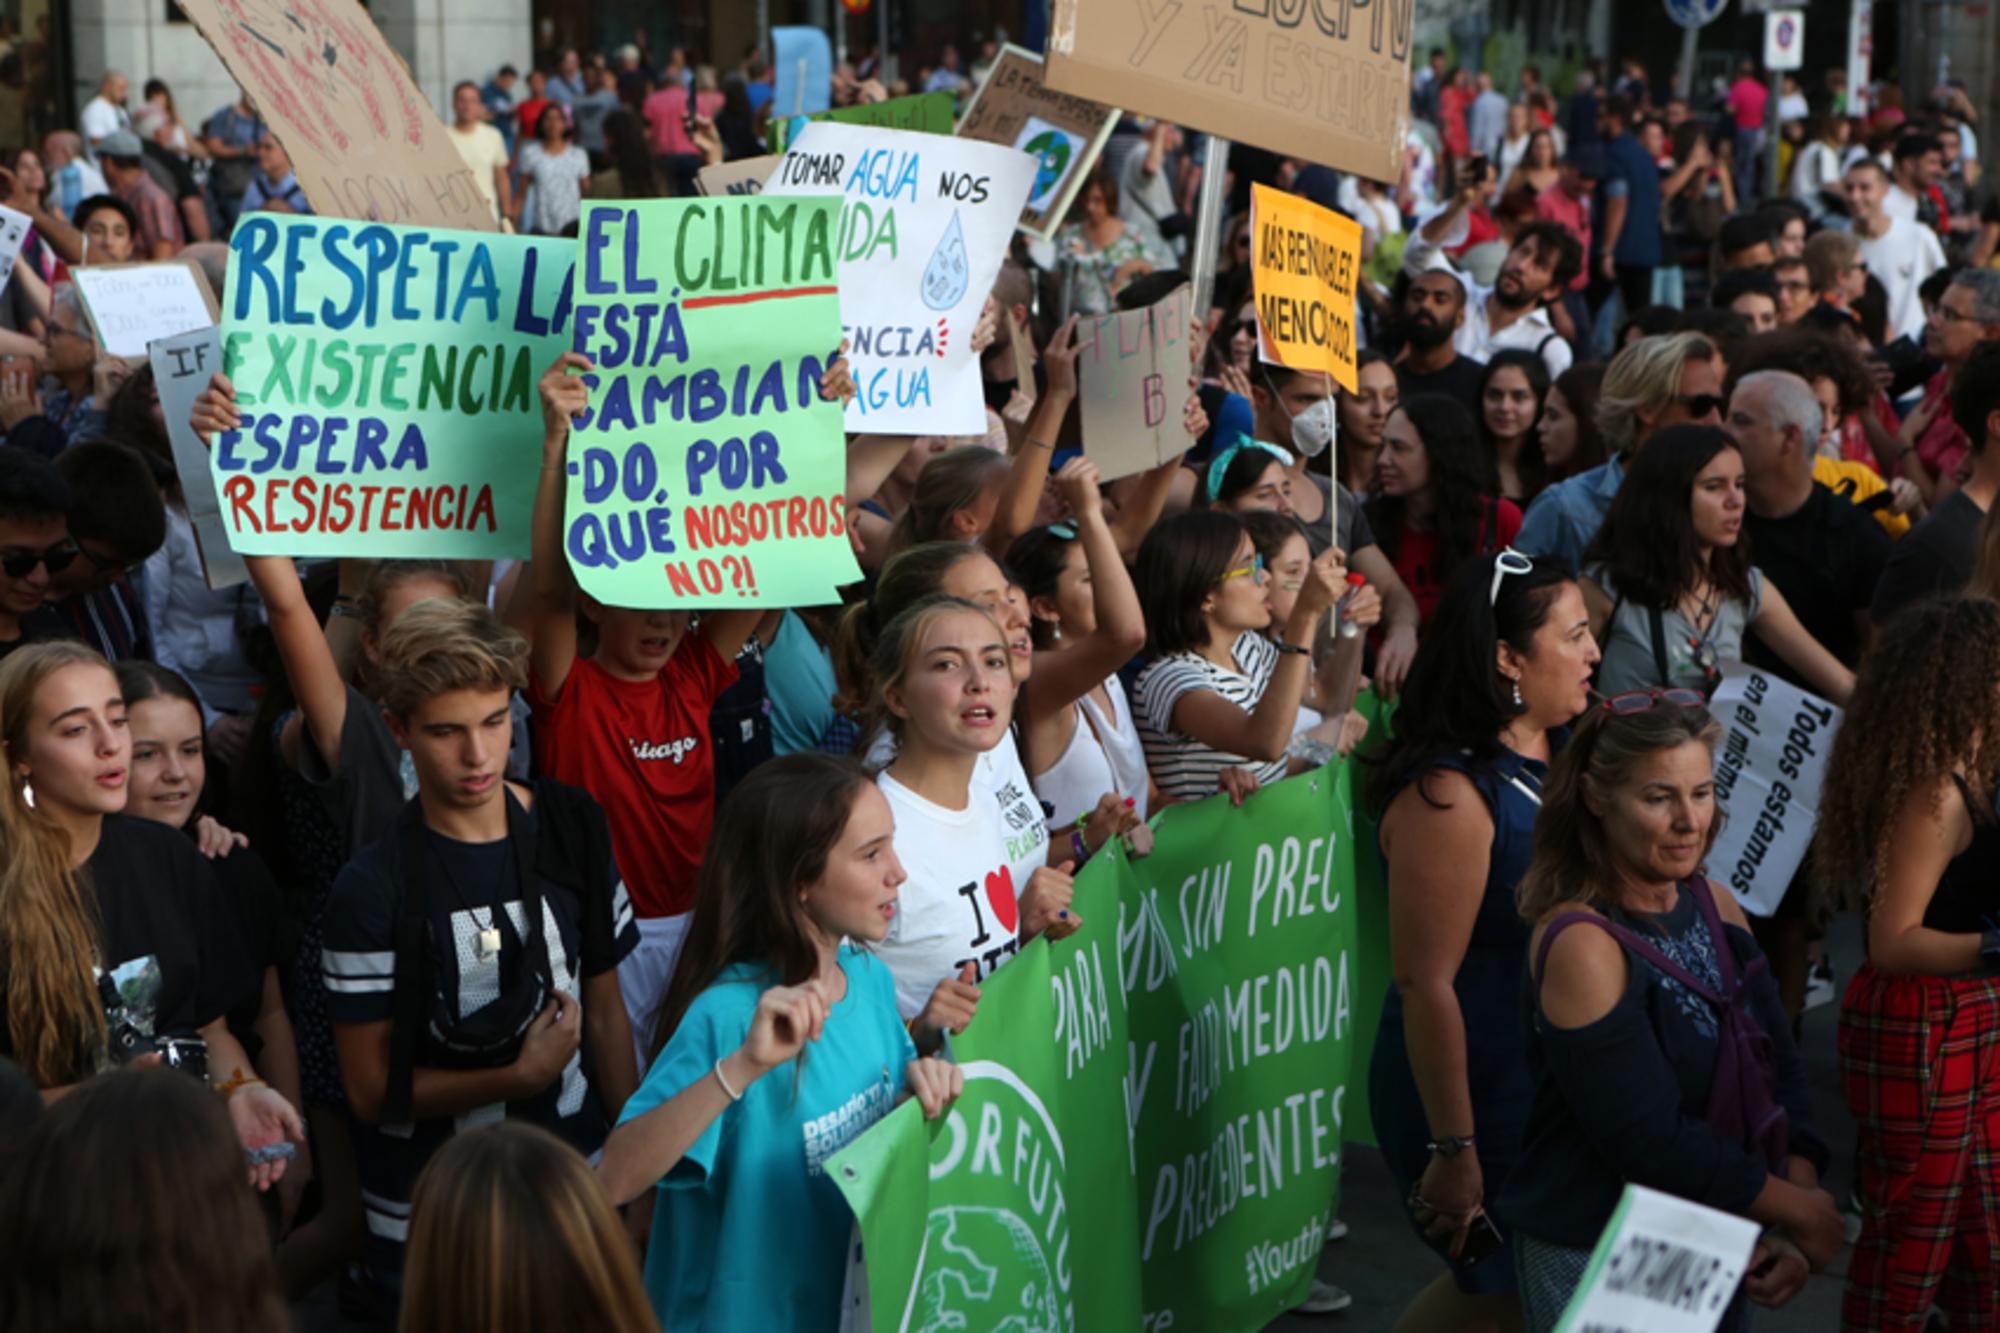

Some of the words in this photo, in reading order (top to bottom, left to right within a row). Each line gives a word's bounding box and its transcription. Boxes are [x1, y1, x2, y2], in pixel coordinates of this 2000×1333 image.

[1183, 4, 1249, 95] YA
[781, 150, 845, 187] TOMAR
[846, 147, 920, 204] AGUA
[937, 170, 991, 204] NOS
[229, 217, 501, 330] RESPETA
[584, 206, 659, 295] EL
[674, 202, 833, 292] CLIMA
[166, 341, 211, 379] IF
[571, 286, 690, 370] ESTÁ
[223, 331, 532, 415] EXISTENCIA
[1143, 372, 1166, 428] B
[217, 412, 429, 475] ESPERA
[685, 429, 788, 496] POR
[223, 474, 497, 534] RESISTENCIA
[567, 488, 676, 570] QUÉ
[683, 493, 846, 551] NOSOTROS
[664, 554, 759, 598] NO?!
[1734, 703, 1761, 737] el
[1743, 672, 1769, 708] en
[1713, 726, 1753, 802] mismo
[1777, 697, 1834, 781] Todos
[1730, 780, 1793, 896] estamos
[958, 879, 991, 948] I
[1178, 860, 1232, 961] SIN
